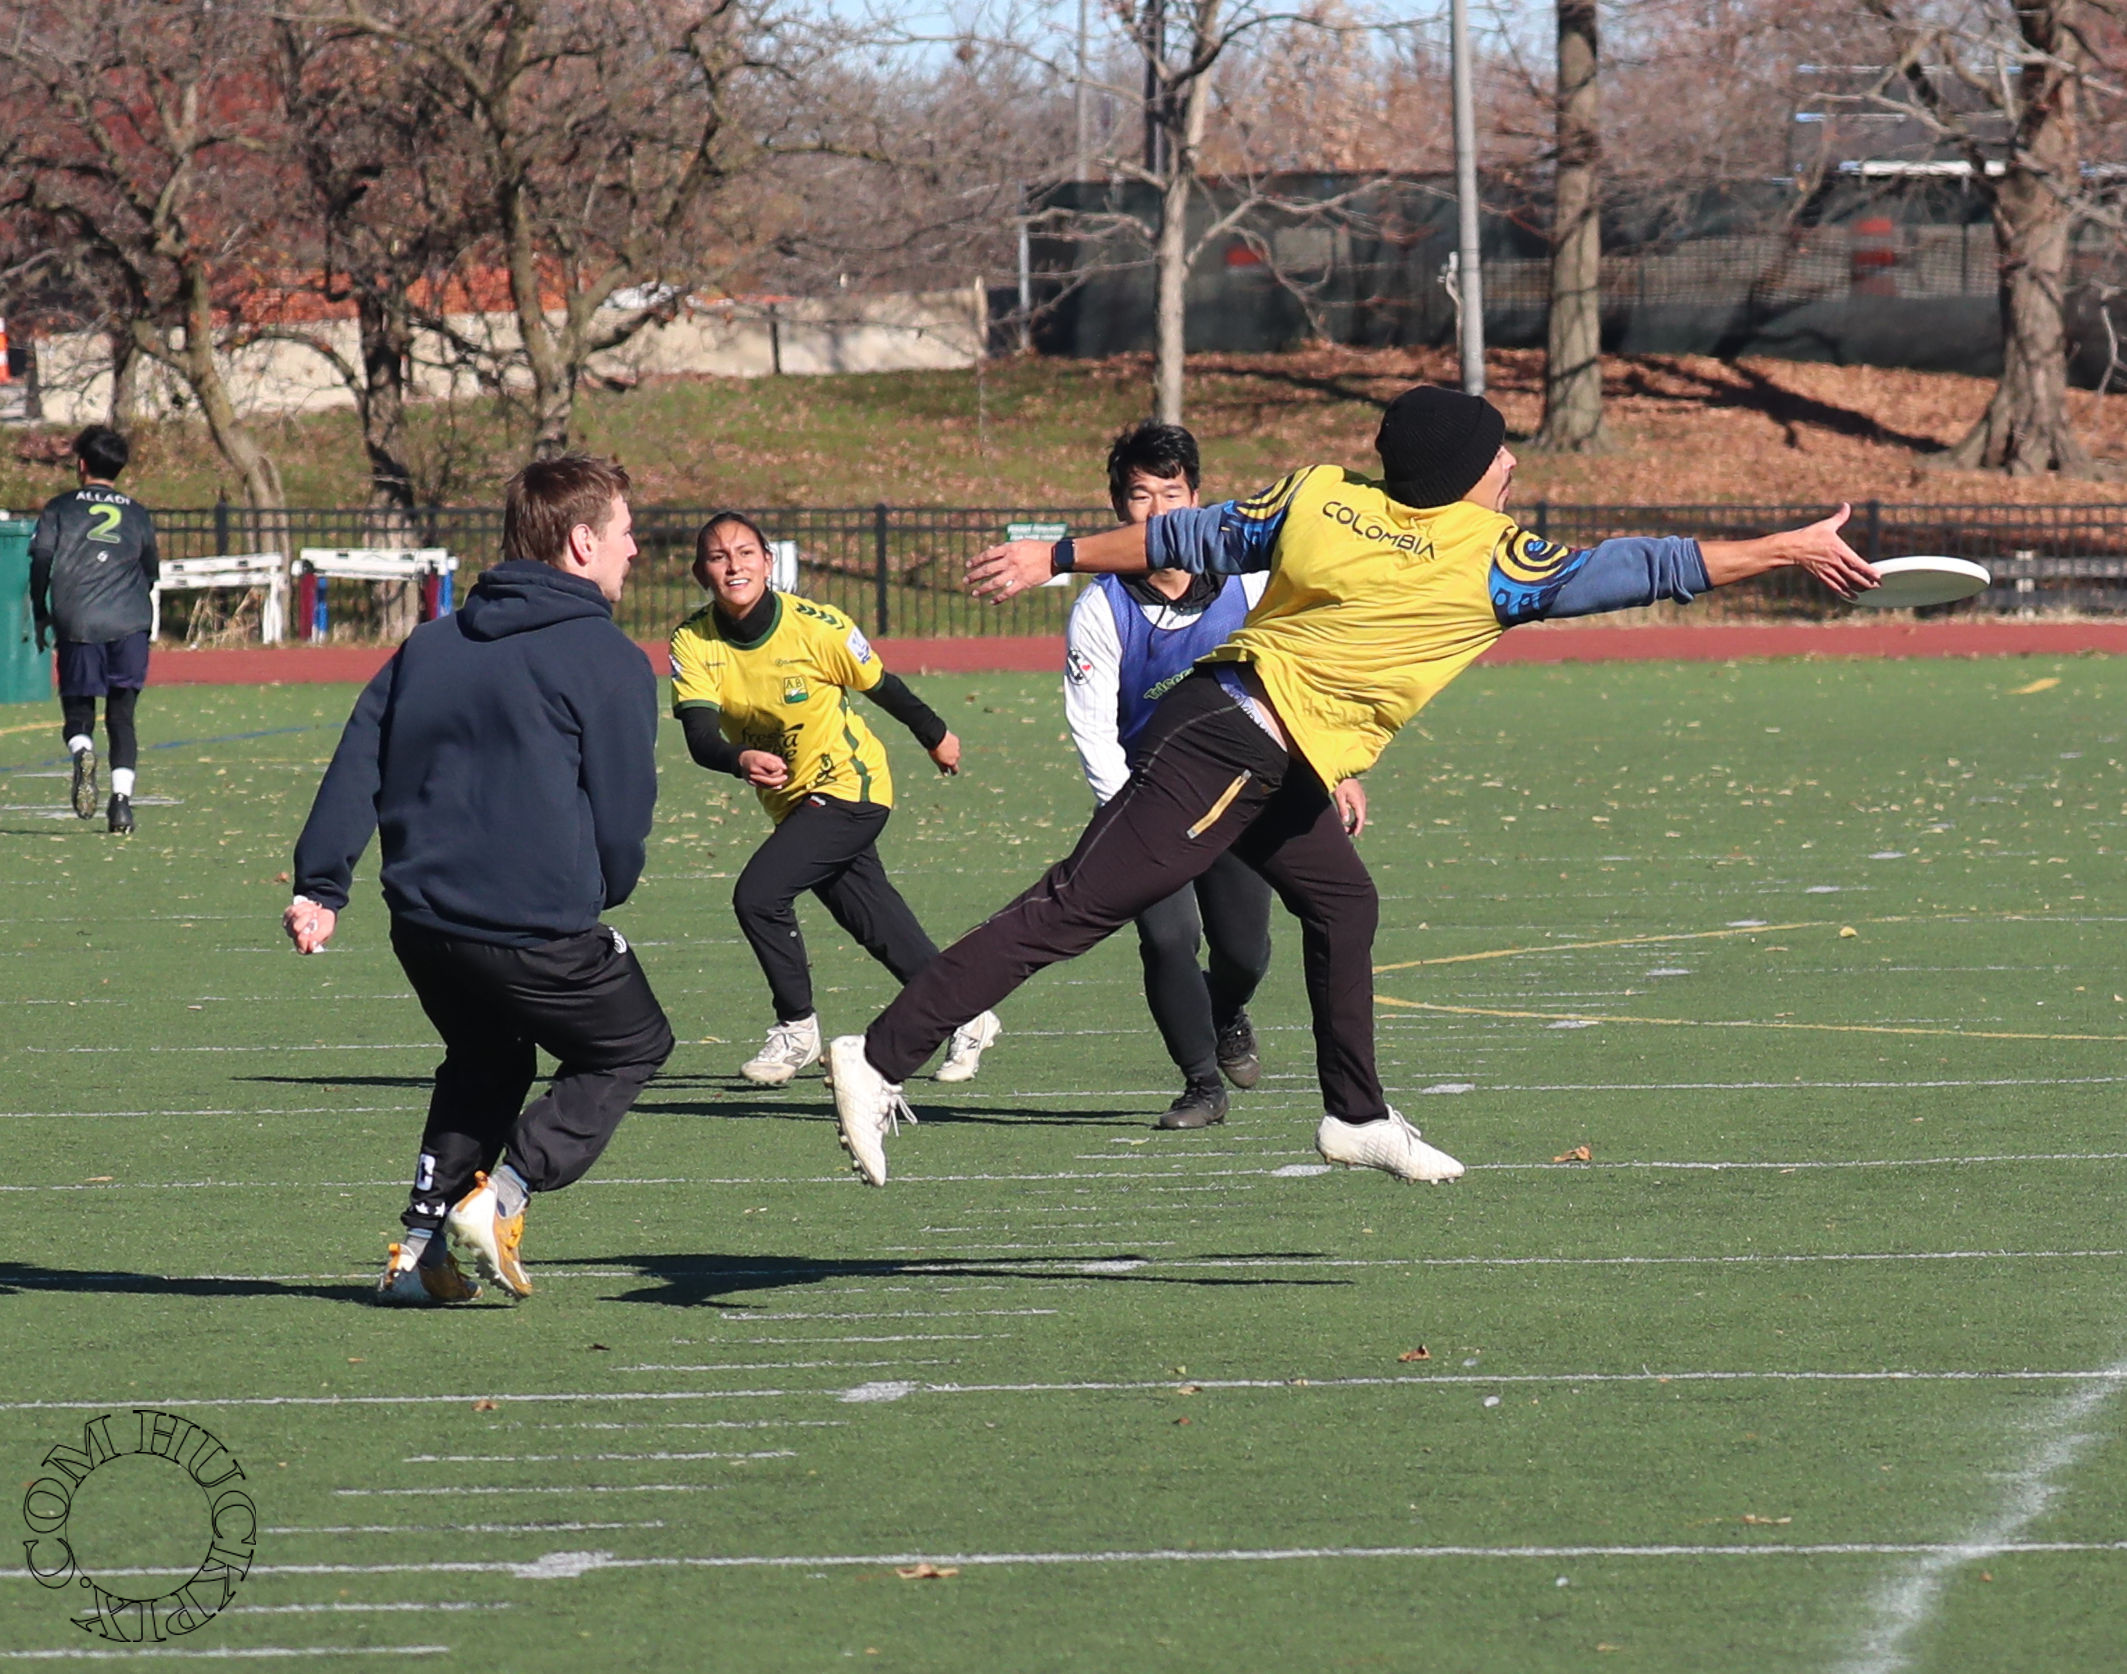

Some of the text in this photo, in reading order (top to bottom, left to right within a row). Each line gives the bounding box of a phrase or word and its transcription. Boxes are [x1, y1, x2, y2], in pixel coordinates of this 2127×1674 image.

[76, 491, 131, 506] ALLADI
[87, 504, 122, 544] 2
[1322, 501, 1435, 559] COLOMBIA
